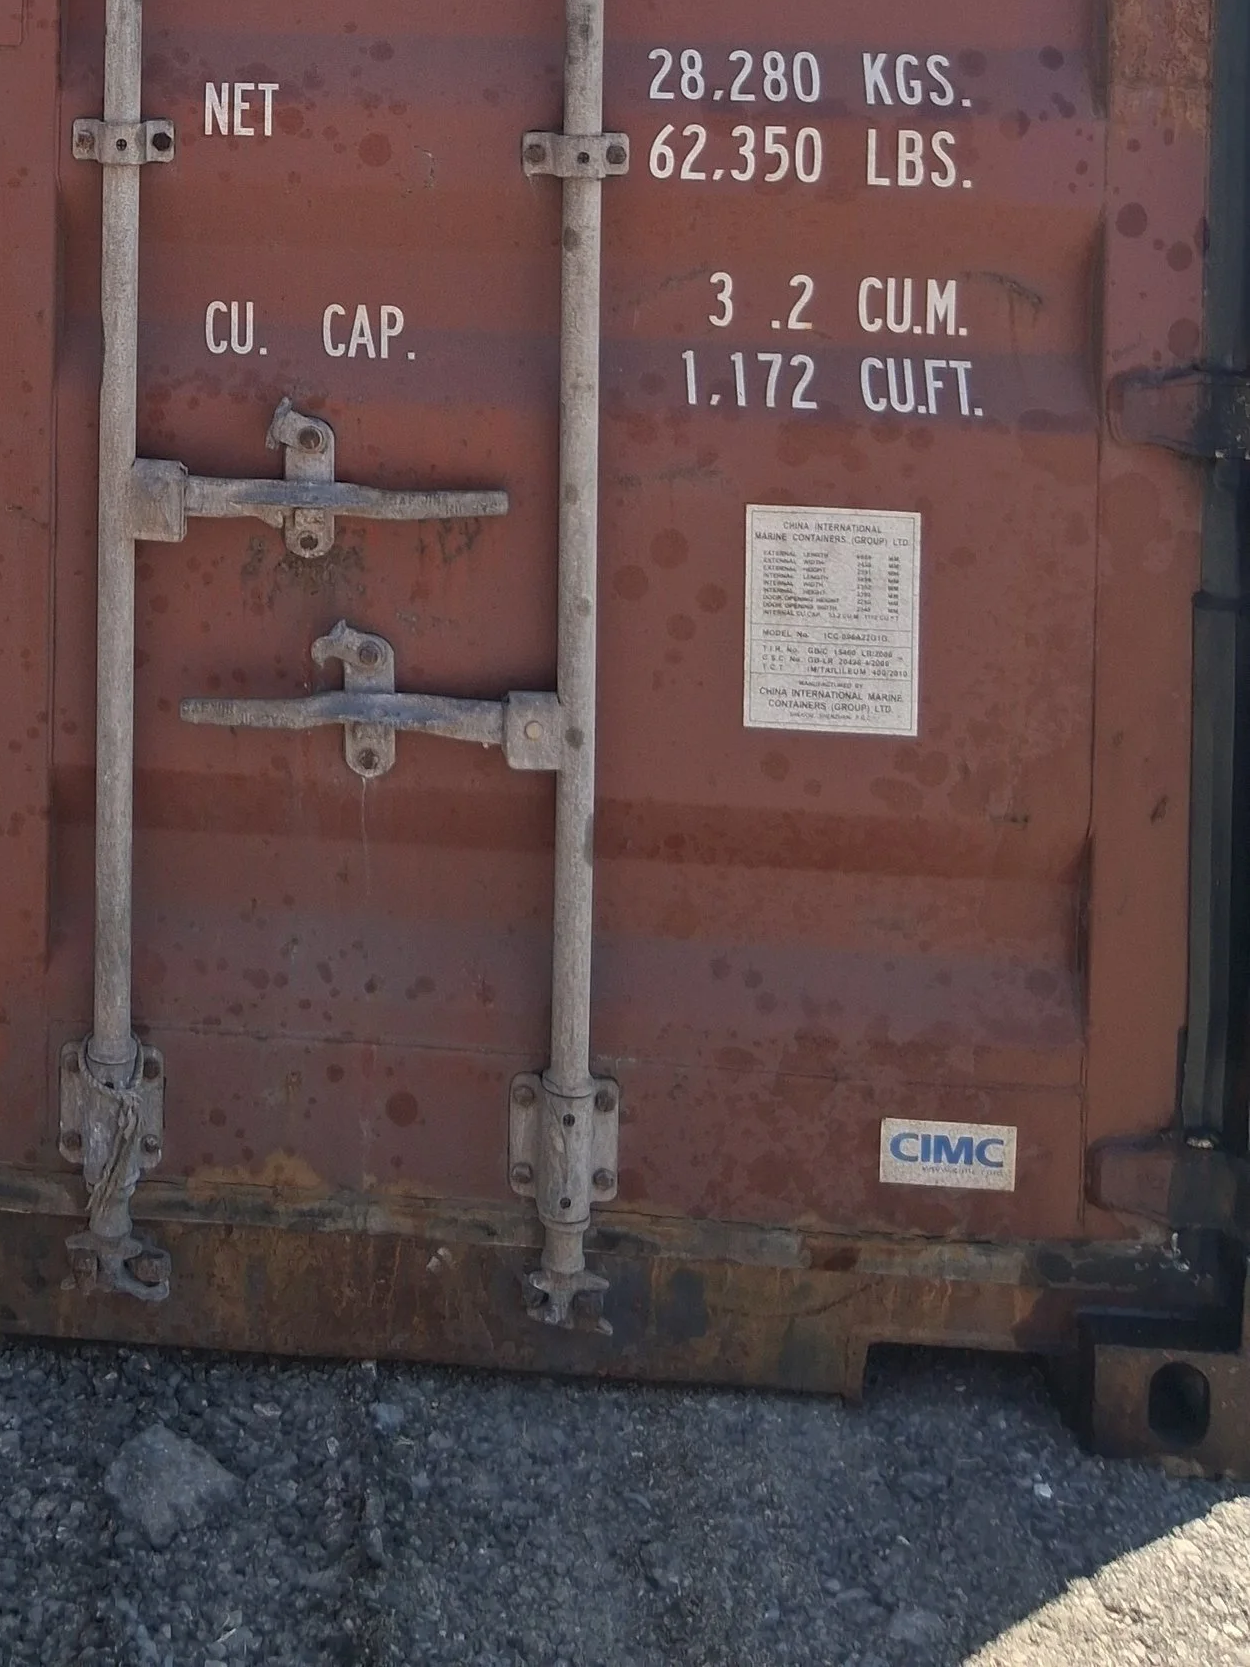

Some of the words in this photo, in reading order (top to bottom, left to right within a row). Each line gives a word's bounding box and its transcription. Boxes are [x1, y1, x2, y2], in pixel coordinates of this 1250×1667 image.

[648, 48, 821, 103] 28,280
[862, 52, 971, 107] KGS.
[204, 82, 279, 137] NET
[649, 124, 823, 183] 62,350
[867, 128, 972, 189] LBS.
[858, 276, 968, 336] CU.M.
[205, 300, 268, 355] CU.
[323, 303, 416, 360] CAP.
[682, 350, 818, 409] 1,172
[860, 357, 983, 417] CU.FT.
[755, 533, 787, 542] MARINE
[793, 534, 846, 544] CONTAINERS
[851, 536, 888, 546] (GROUP)
[783, 521, 809, 530] CHINA
[815, 523, 882, 534] INTERNATIONAL
[762, 629, 792, 637] MODEL
[759, 686, 788, 696] CHINA
[792, 689, 863, 700] INTERNATIONAL
[868, 692, 903, 703] MARINE
[768, 699, 827, 710] CONTAINERS
[831, 702, 871, 713] (GROUP)
[889, 1132, 1004, 1168] CIMC
